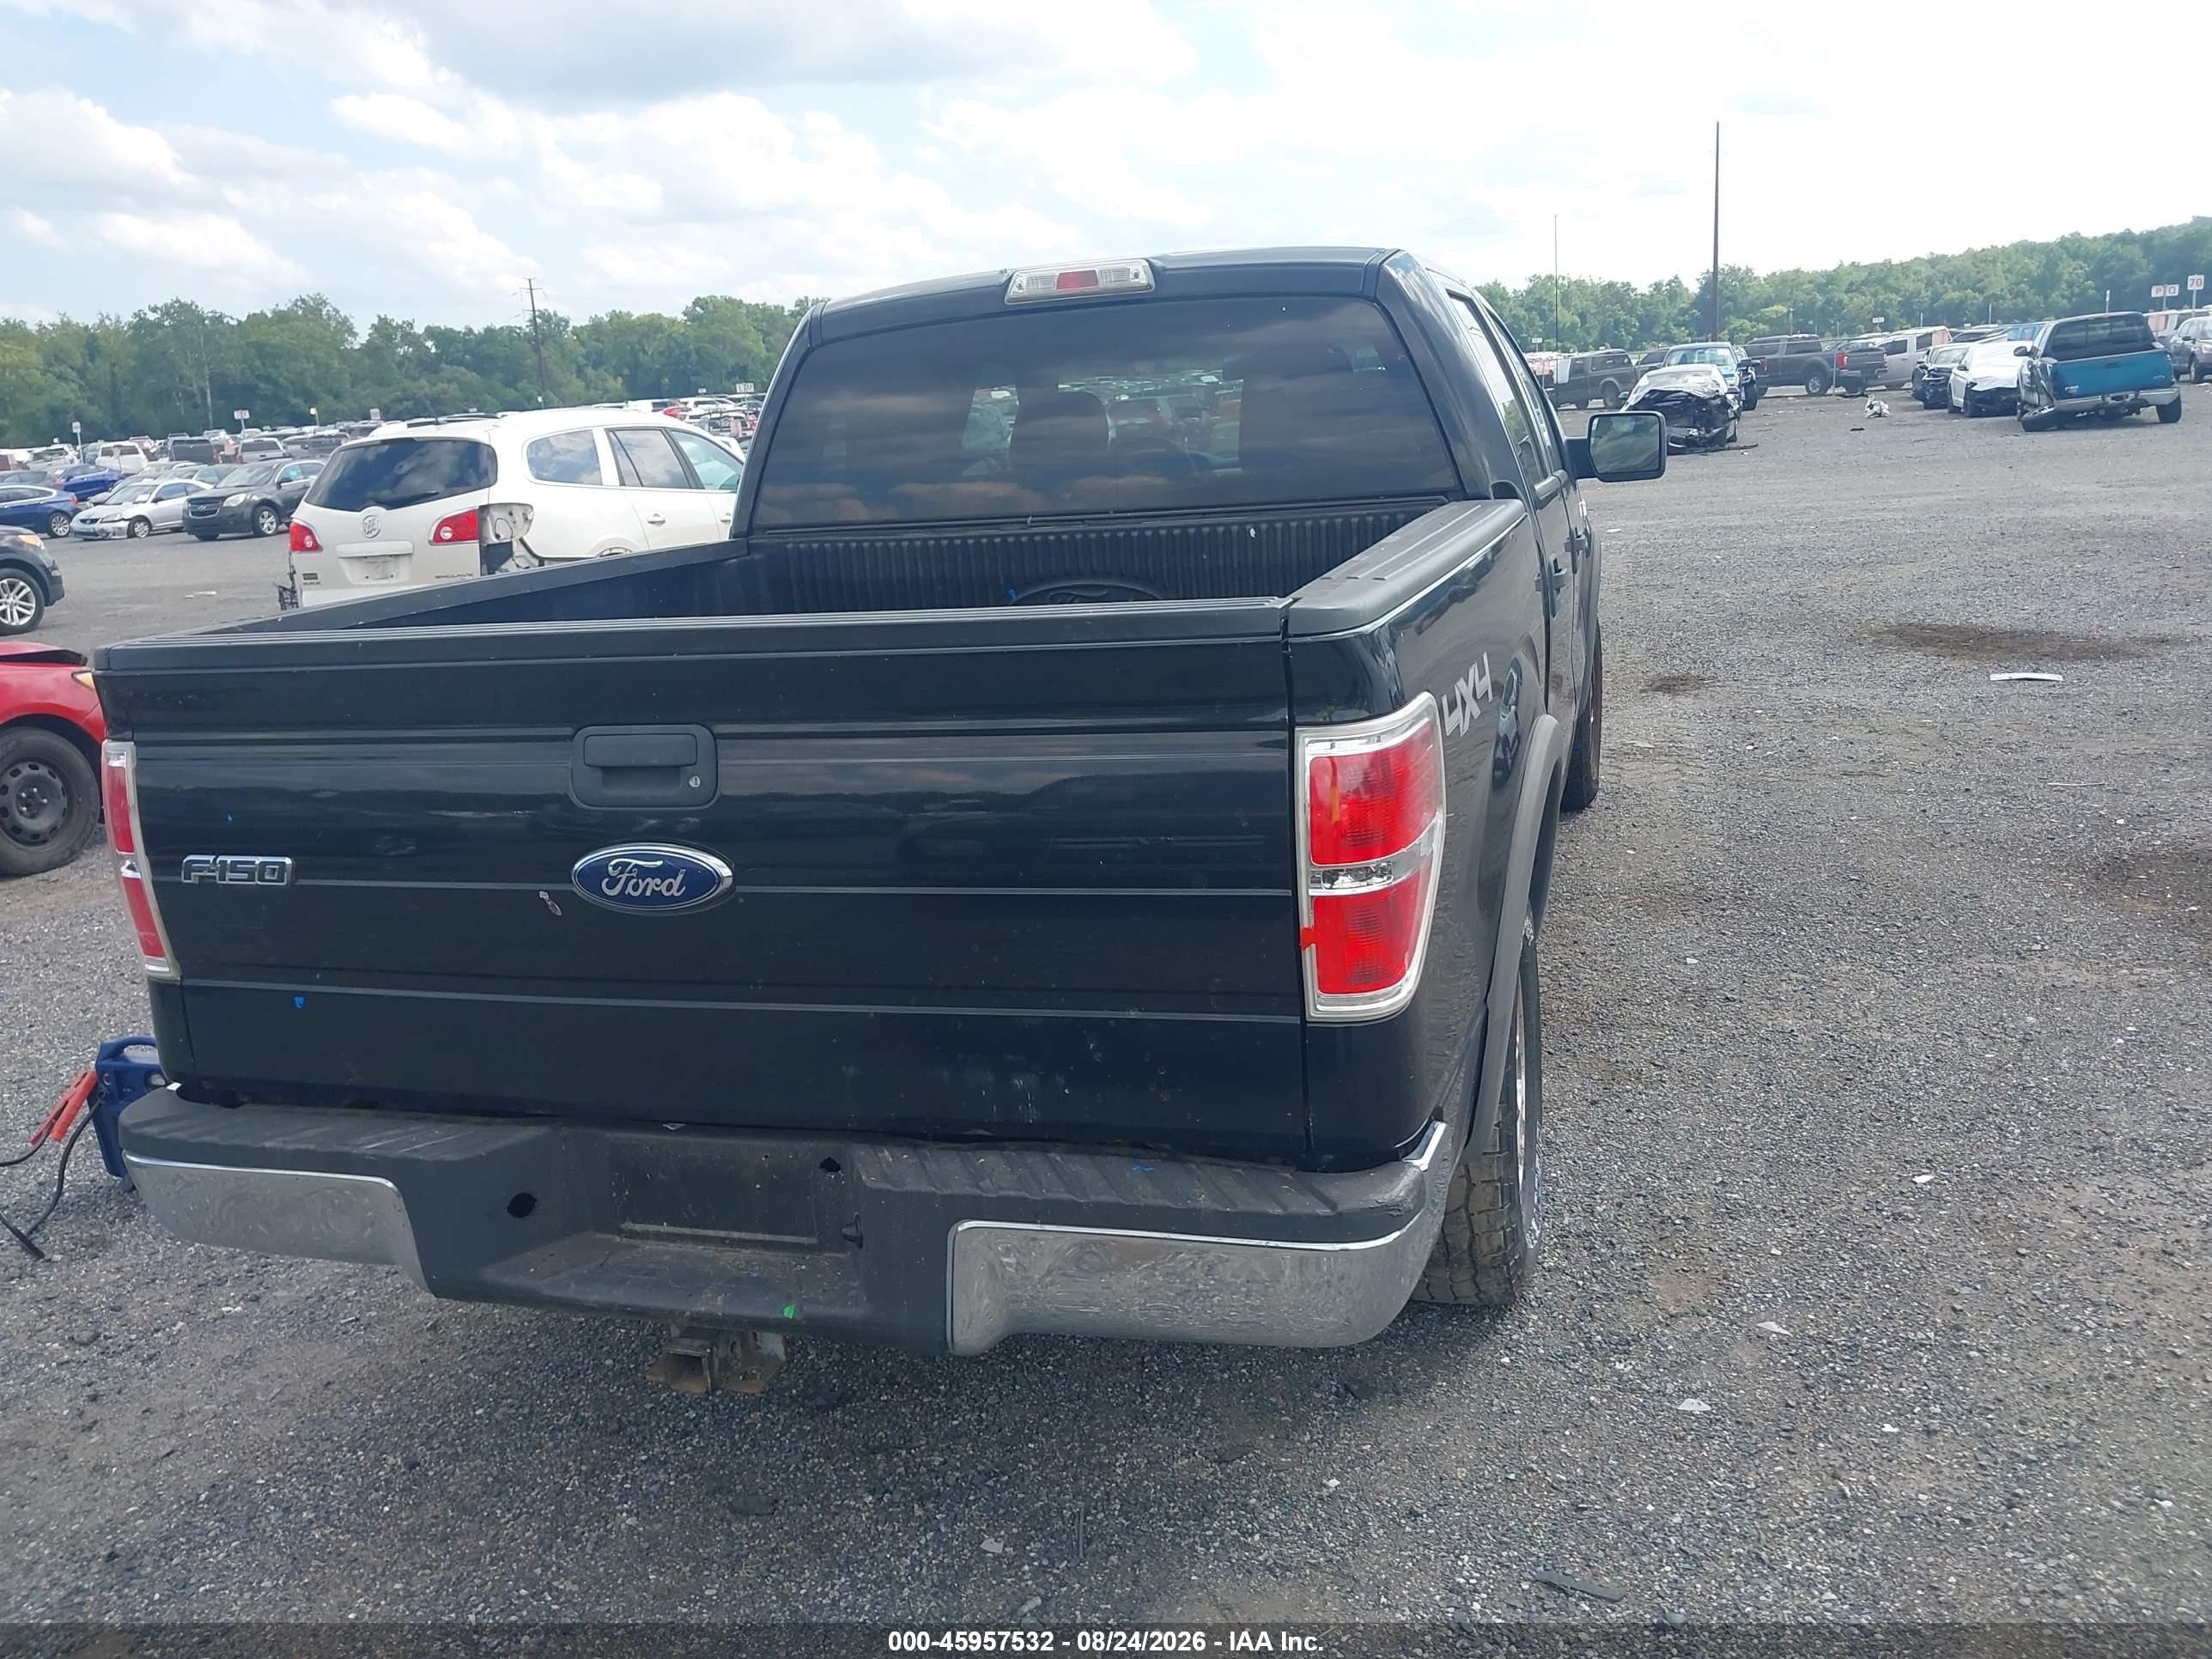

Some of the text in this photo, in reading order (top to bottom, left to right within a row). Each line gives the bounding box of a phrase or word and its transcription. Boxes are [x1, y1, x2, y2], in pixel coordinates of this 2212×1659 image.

[2189, 279, 2203, 288] 70
[181, 854, 294, 886] F-150
[601, 858, 686, 896] Ford
